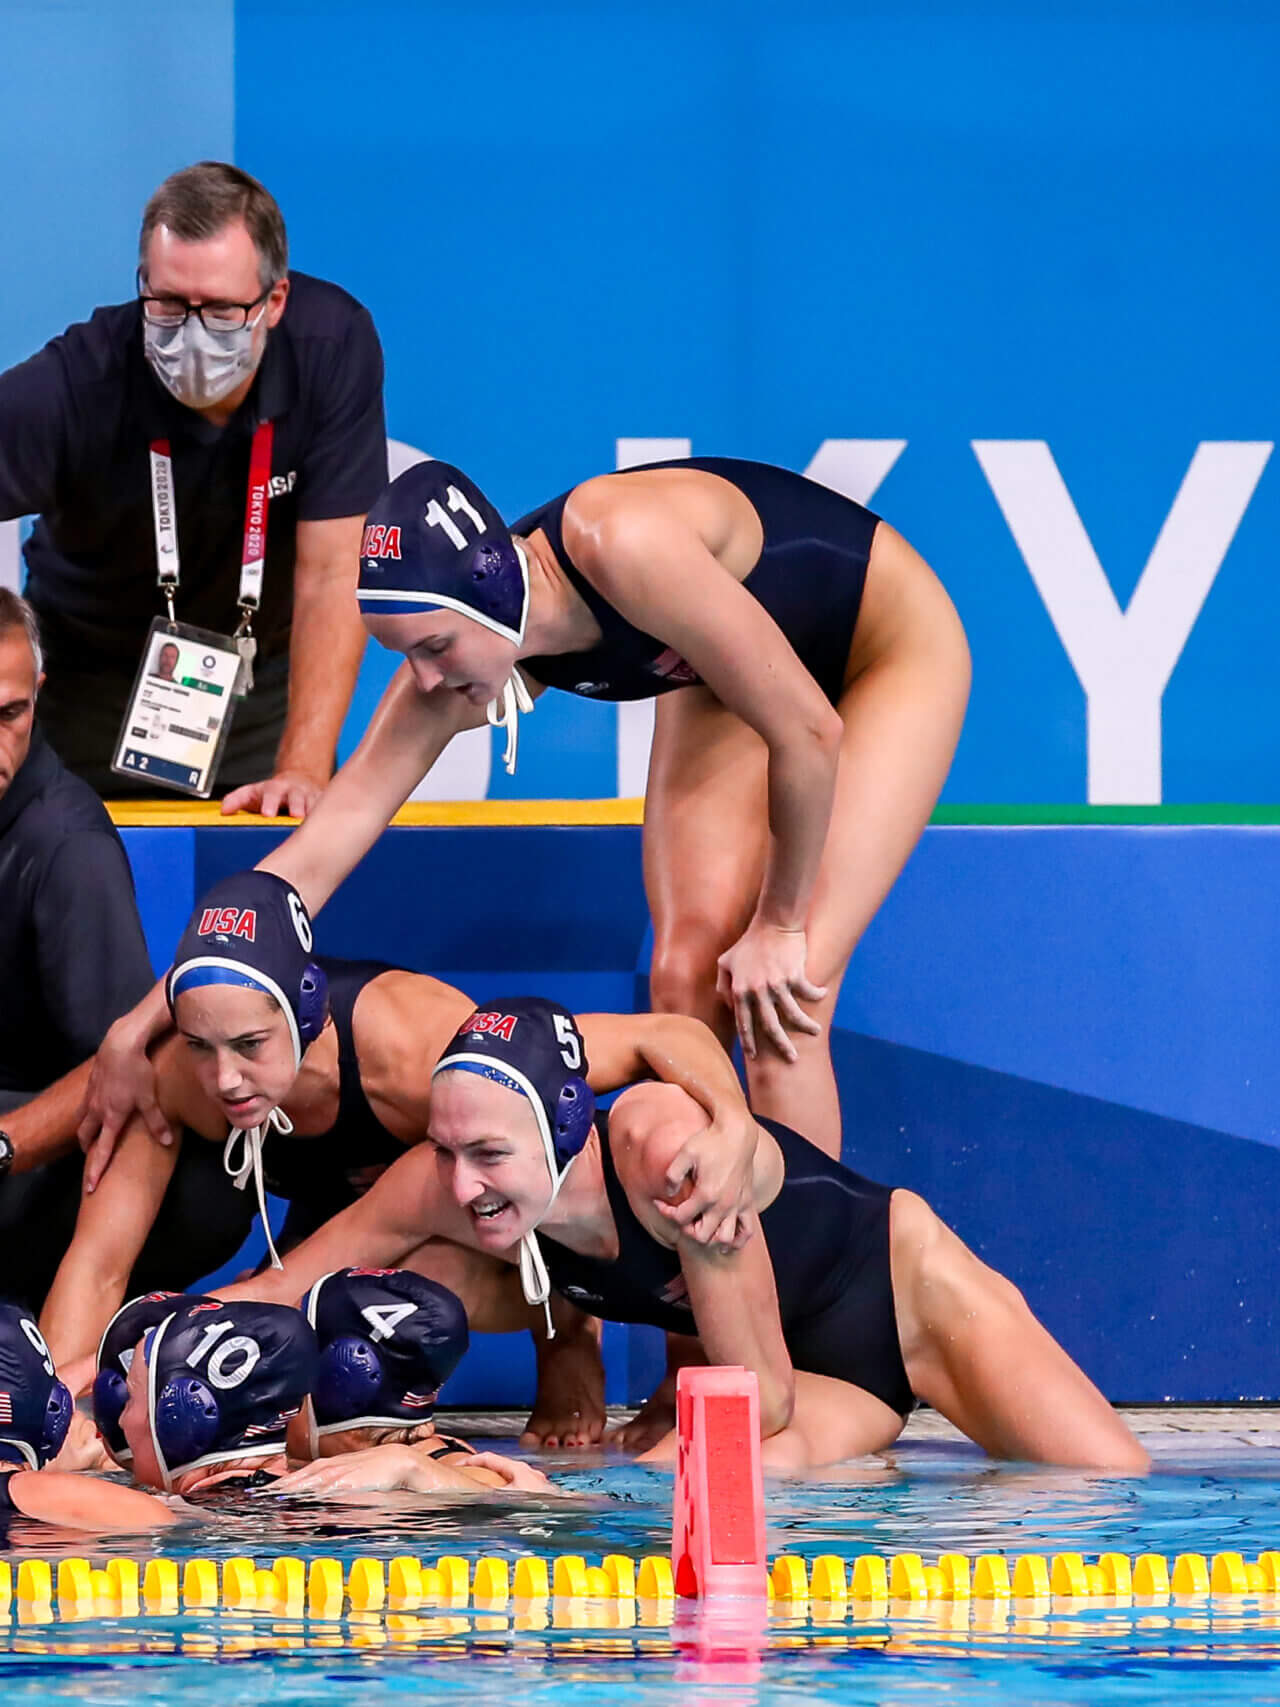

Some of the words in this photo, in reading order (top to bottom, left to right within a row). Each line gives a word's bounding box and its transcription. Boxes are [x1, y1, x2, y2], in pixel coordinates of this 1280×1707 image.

[156, 461, 169, 490] 2020
[158, 492, 171, 532] TOKYO
[250, 485, 265, 525] TOKYO
[425, 484, 487, 551] 11
[247, 525, 261, 556] 2020
[139, 757, 149, 769] 2
[198, 907, 257, 942] USA
[287, 892, 313, 953] 6
[460, 1012, 518, 1041] USA
[552, 1014, 581, 1069] 5
[361, 1302, 419, 1343] 4
[20, 1318, 55, 1377] 9
[185, 1319, 260, 1390] 10
